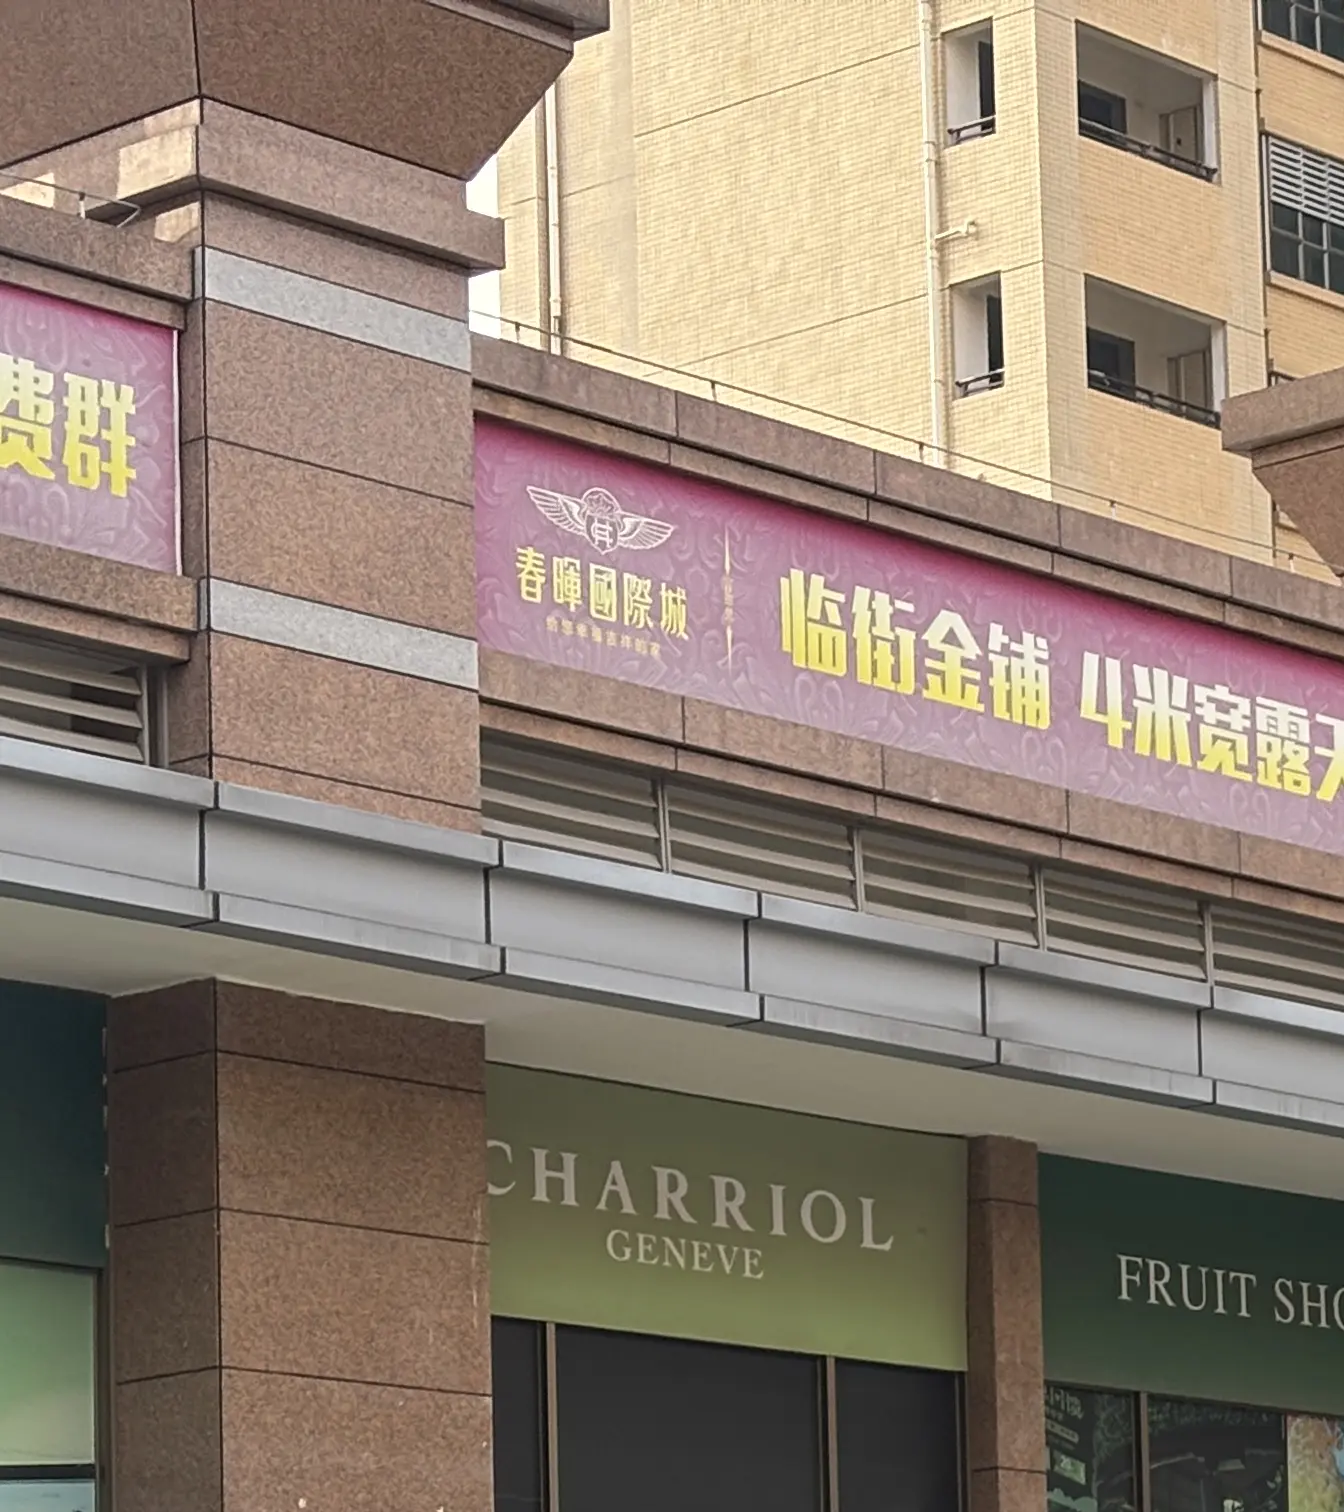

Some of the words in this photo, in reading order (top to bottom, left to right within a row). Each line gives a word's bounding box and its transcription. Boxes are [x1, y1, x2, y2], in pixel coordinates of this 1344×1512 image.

[779, 567, 1051, 731] 临街金铺
[485, 1139, 896, 1252] CHARRIOL
[605, 1228, 764, 1280] GENEVE
[1116, 1253, 1258, 1318] FRUIT
